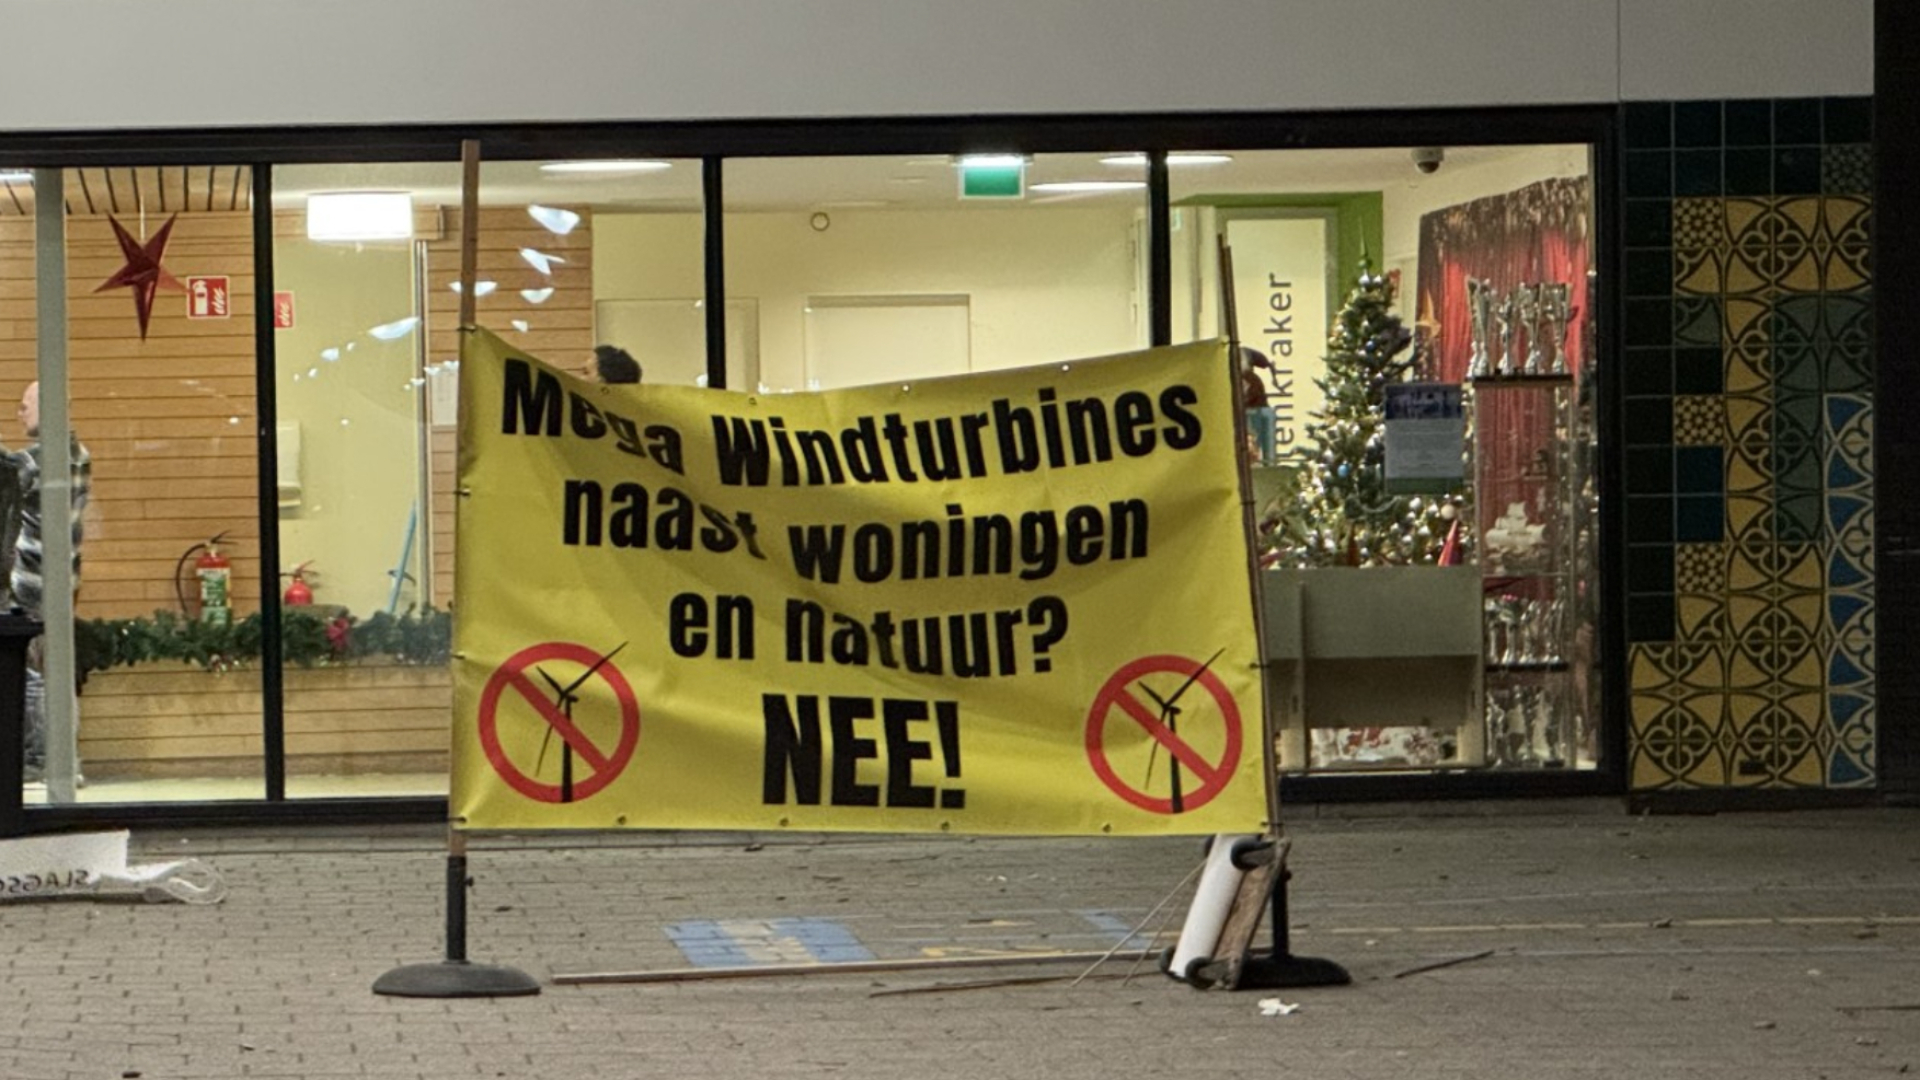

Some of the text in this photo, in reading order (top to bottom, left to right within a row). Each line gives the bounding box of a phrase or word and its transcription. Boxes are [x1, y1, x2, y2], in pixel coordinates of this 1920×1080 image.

[502, 357, 1202, 487] Mega Windturbines
[562, 478, 1150, 585] naast woningen
[669, 592, 1069, 679] en natuur?
[761, 693, 966, 810] NEE!
